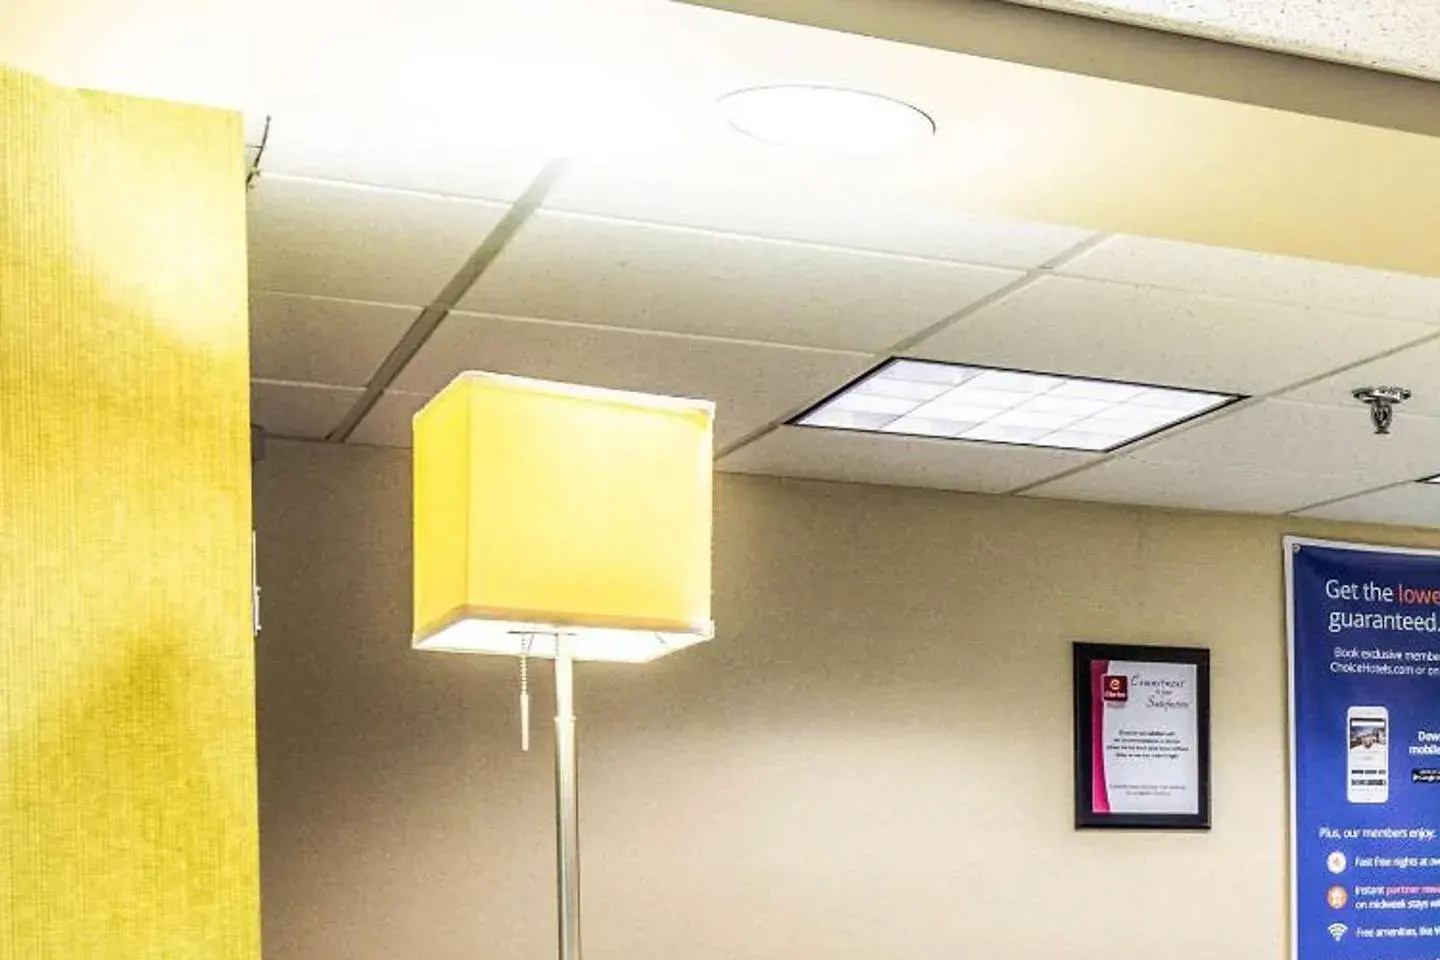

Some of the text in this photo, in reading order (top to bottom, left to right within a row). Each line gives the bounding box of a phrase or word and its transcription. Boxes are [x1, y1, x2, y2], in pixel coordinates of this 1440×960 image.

[1326, 579, 1359, 600] Get
[1363, 581, 1393, 602] the
[1328, 611, 1440, 633] guaranteed.
[1334, 647, 1358, 658] Book
[1361, 648, 1402, 660] exclusive
[1330, 662, 1413, 675] ChoiceHotels.com
[1415, 667, 1425, 675] or
[1428, 668, 1439, 676] on
[1319, 827, 1341, 839] Plus,
[1344, 829, 1359, 838] our
[1362, 828, 1408, 838] members
[1355, 856, 1372, 867] Fast
[1374, 856, 1391, 867] free
[1393, 856, 1418, 868] nights
[1420, 858, 1428, 866] at
[1355, 886, 1384, 896] Instant
[1355, 901, 1367, 909] on
[1369, 899, 1406, 909] midweek
[1407, 900, 1429, 911] stays
[1356, 927, 1374, 937] Free
[1419, 926, 1433, 936] like
